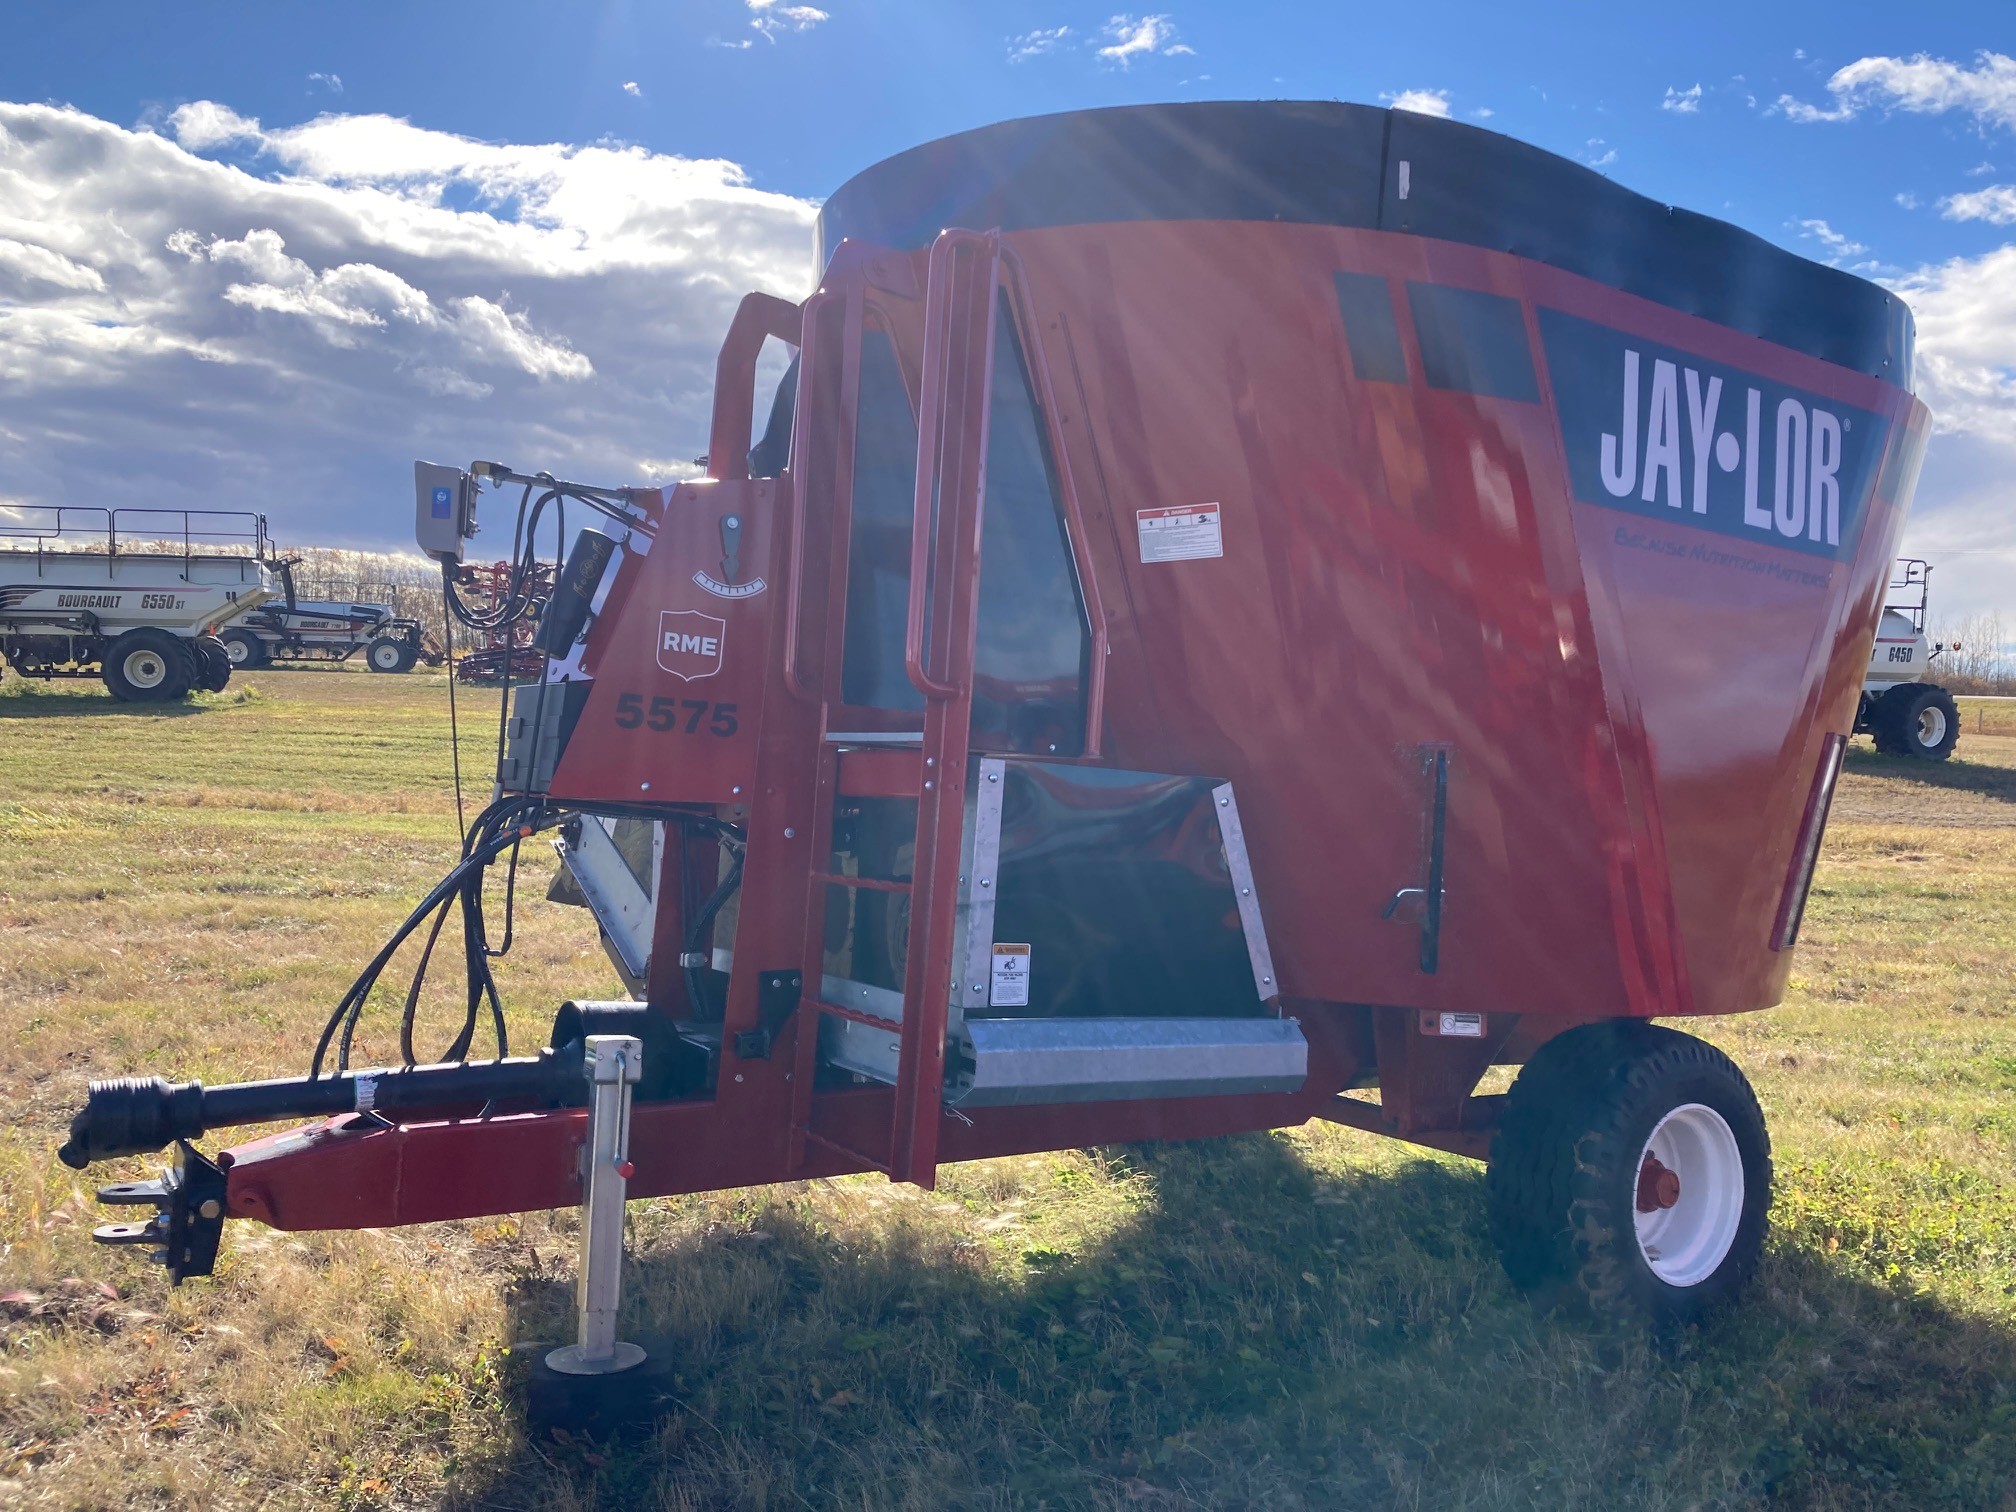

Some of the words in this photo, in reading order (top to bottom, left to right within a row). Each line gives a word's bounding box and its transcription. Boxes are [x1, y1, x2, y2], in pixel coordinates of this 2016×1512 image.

[57, 594, 122, 609] BOURGAULT
[141, 594, 175, 609] 6550
[176, 600, 186, 610] ST
[663, 631, 718, 656] RME
[1889, 647, 1913, 662] 6450
[615, 692, 739, 738] 5575
